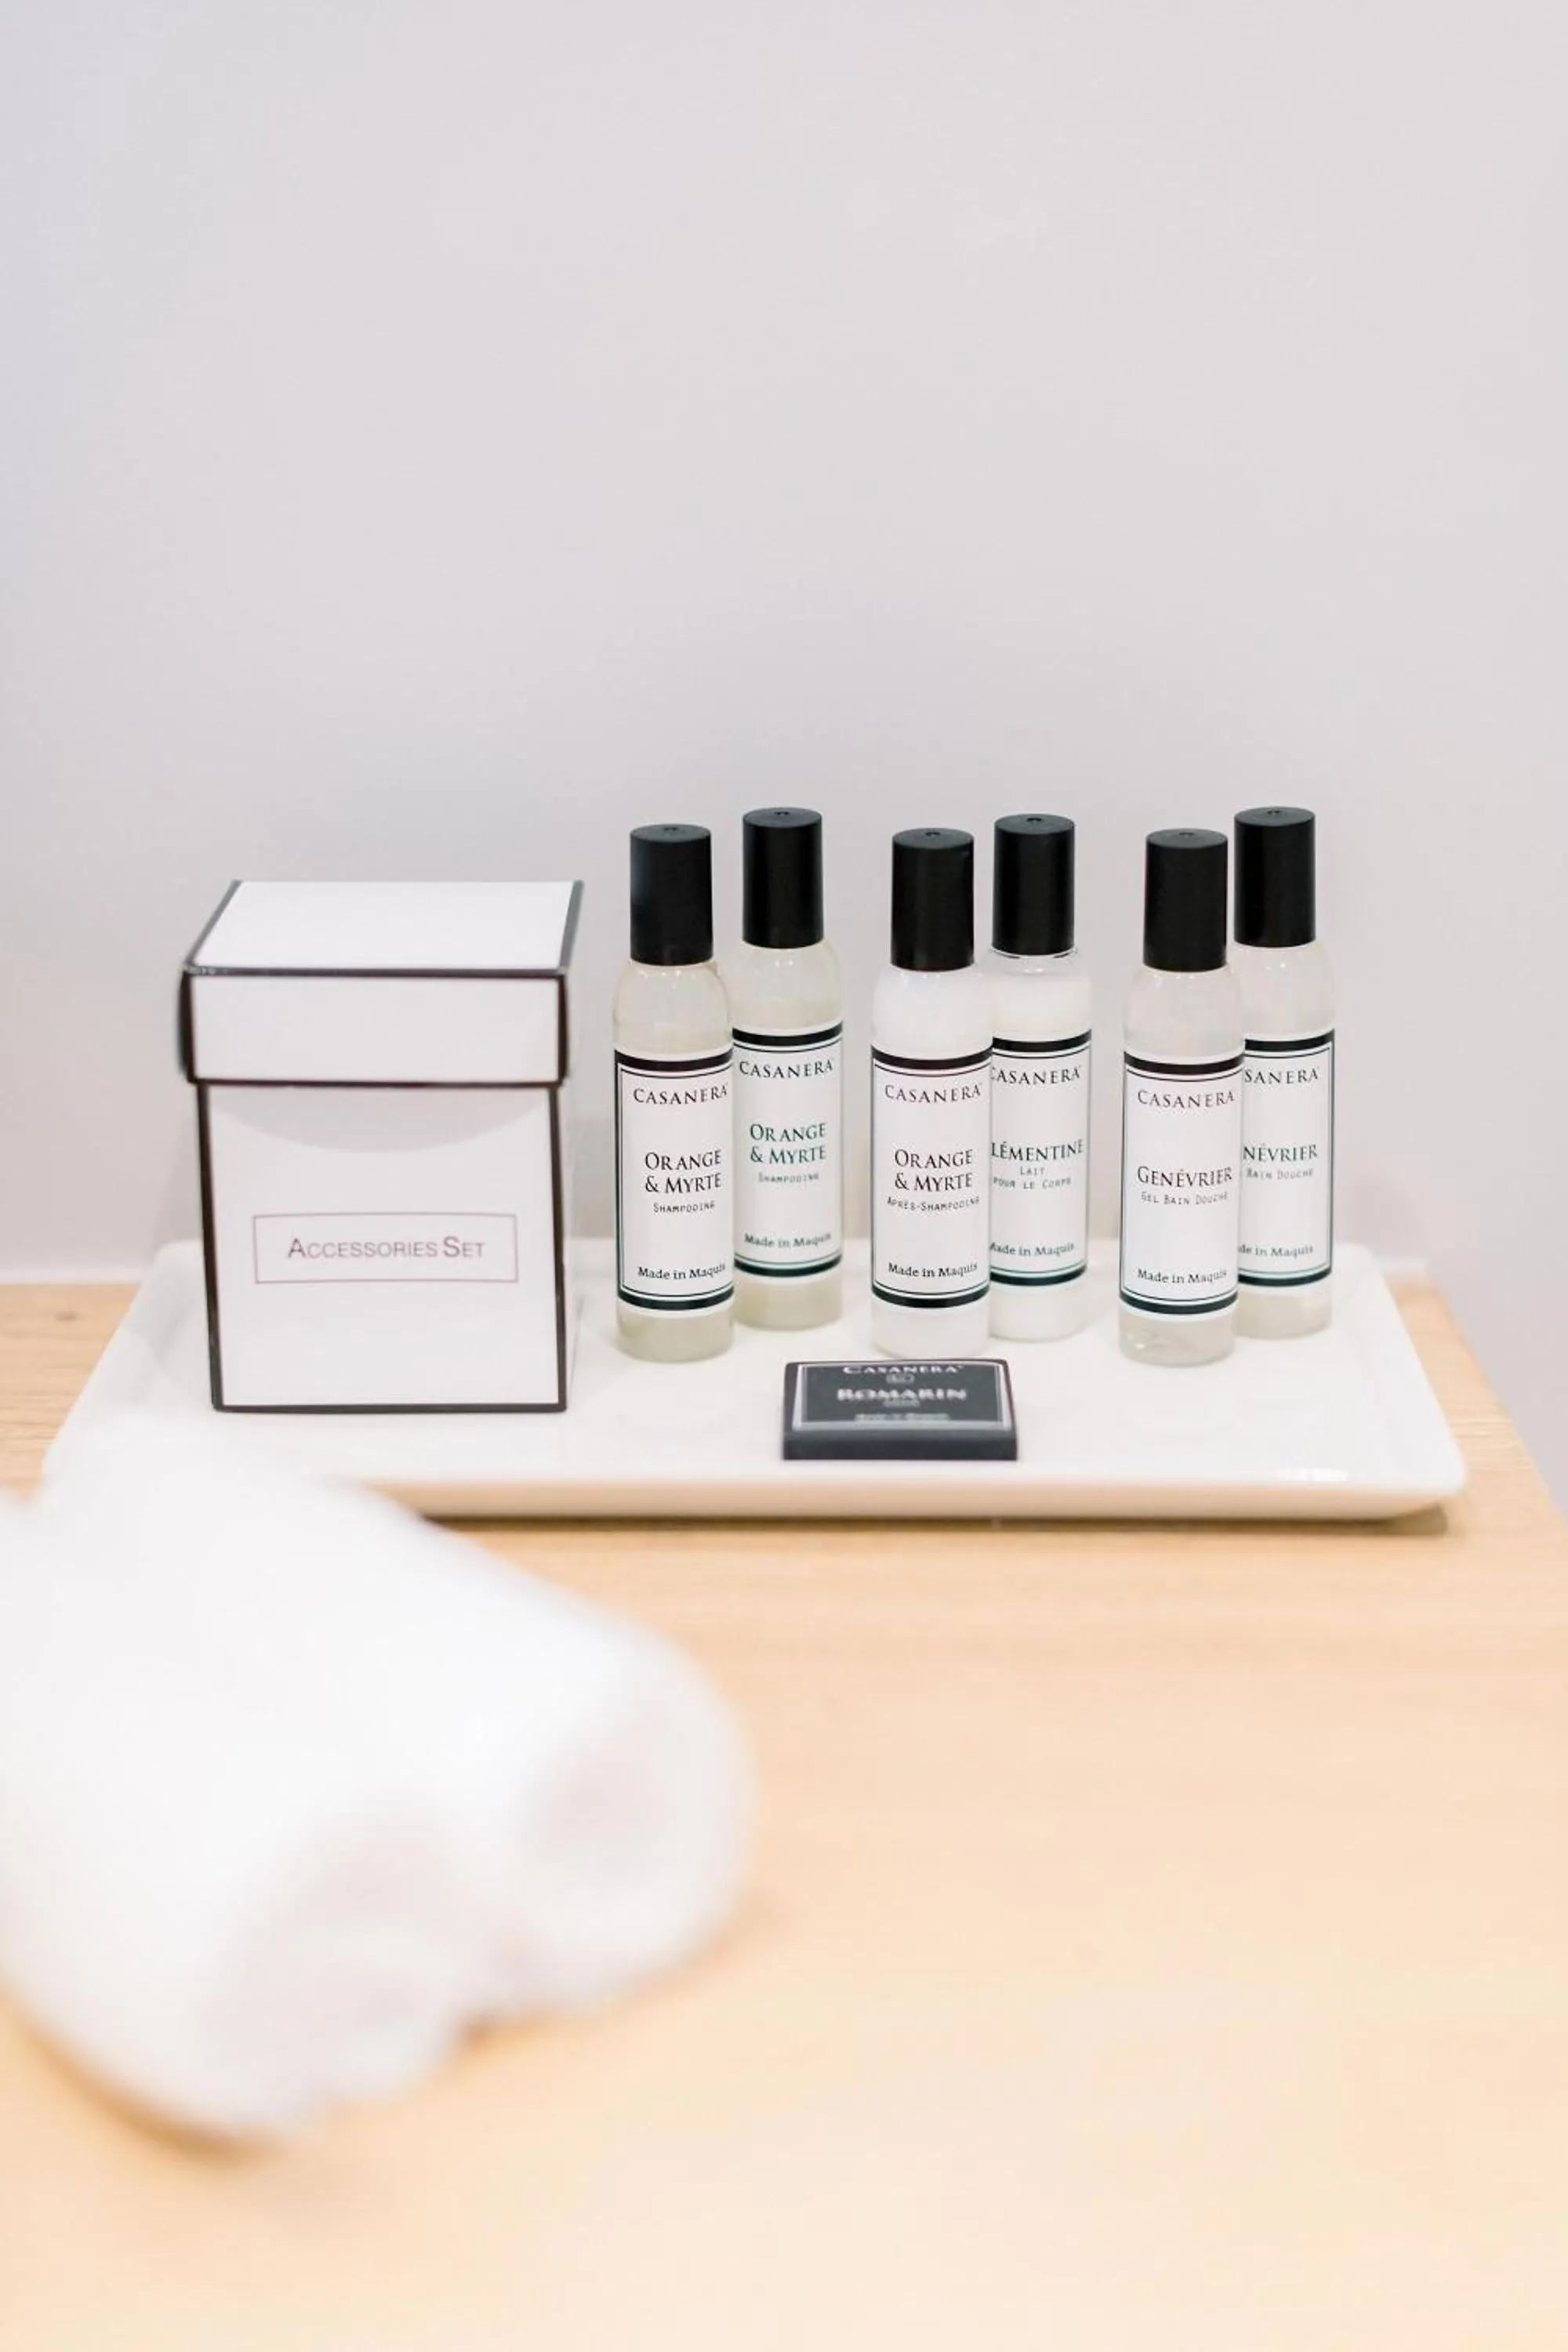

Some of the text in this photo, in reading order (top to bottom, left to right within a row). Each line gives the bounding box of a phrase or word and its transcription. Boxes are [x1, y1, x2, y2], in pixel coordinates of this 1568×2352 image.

[739, 1059, 833, 1079] CASANERA
[1245, 1069, 1318, 1083] SANERA
[633, 1084, 727, 1105] CASANERA
[884, 1083, 980, 1103] CASANERA
[1138, 1090, 1234, 1109] CASANERA
[750, 1123, 826, 1142] ORANGE
[750, 1145, 826, 1164] & MYRTE
[991, 1138, 1084, 1160] LÉMENTINE
[1243, 1144, 1317, 1162] NÉVRIER
[645, 1150, 721, 1170] ORANGE
[895, 1149, 973, 1169] ORANGE
[1020, 1167, 1044, 1175] LAIT
[1138, 1166, 1232, 1188] GENÉVRIER
[645, 1173, 721, 1193] & MYRTE
[895, 1173, 973, 1192] & MYRTE
[288, 1236, 486, 1258] ACCESSORIES SET
[744, 1232, 775, 1247] Made
[778, 1239, 790, 1248] in
[1018, 1245, 1031, 1256] in
[1035, 1243, 1074, 1256] Maquis
[637, 1264, 725, 1280] Made in Maquis
[887, 1261, 978, 1279] Made in Maquis
[1137, 1269, 1227, 1285] Made in Maquis
